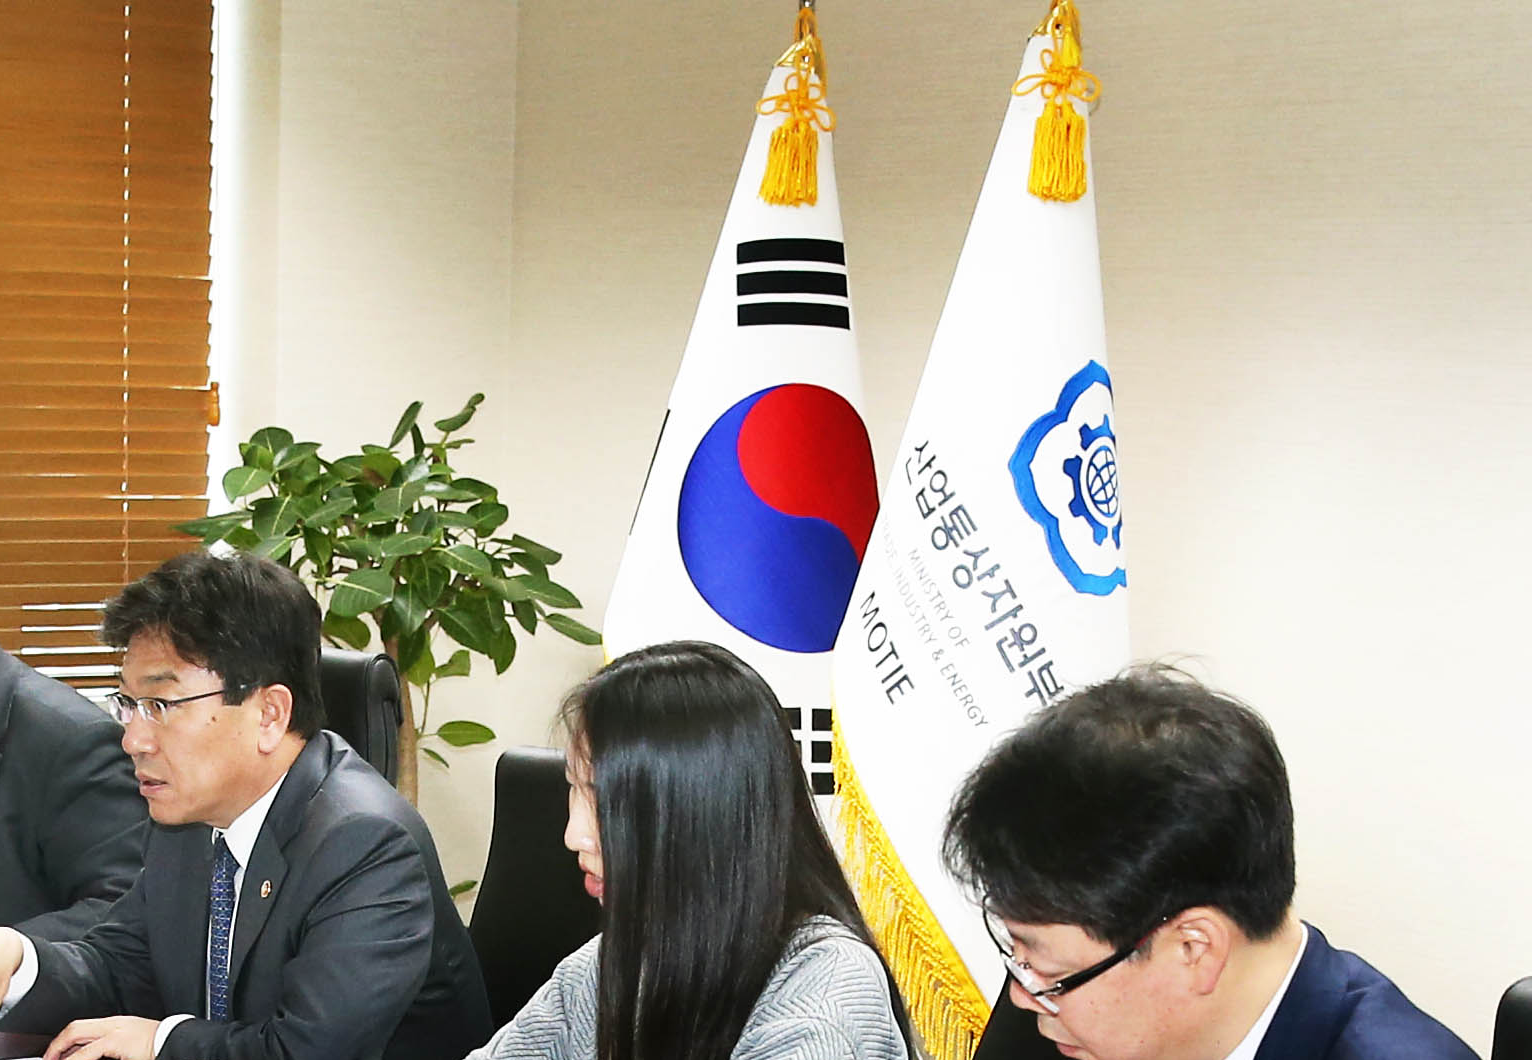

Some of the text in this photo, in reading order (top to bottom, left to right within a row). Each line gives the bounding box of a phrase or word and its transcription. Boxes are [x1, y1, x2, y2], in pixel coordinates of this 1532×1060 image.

[905, 440, 1064, 707] 산업통상자원부
[908, 547, 972, 649] MINISTRY OF
[859, 590, 916, 706] MOTIE
[892, 566, 938, 645] INDUSTRY
[931, 648, 945, 662] &
[940, 662, 989, 727] ENERGY
